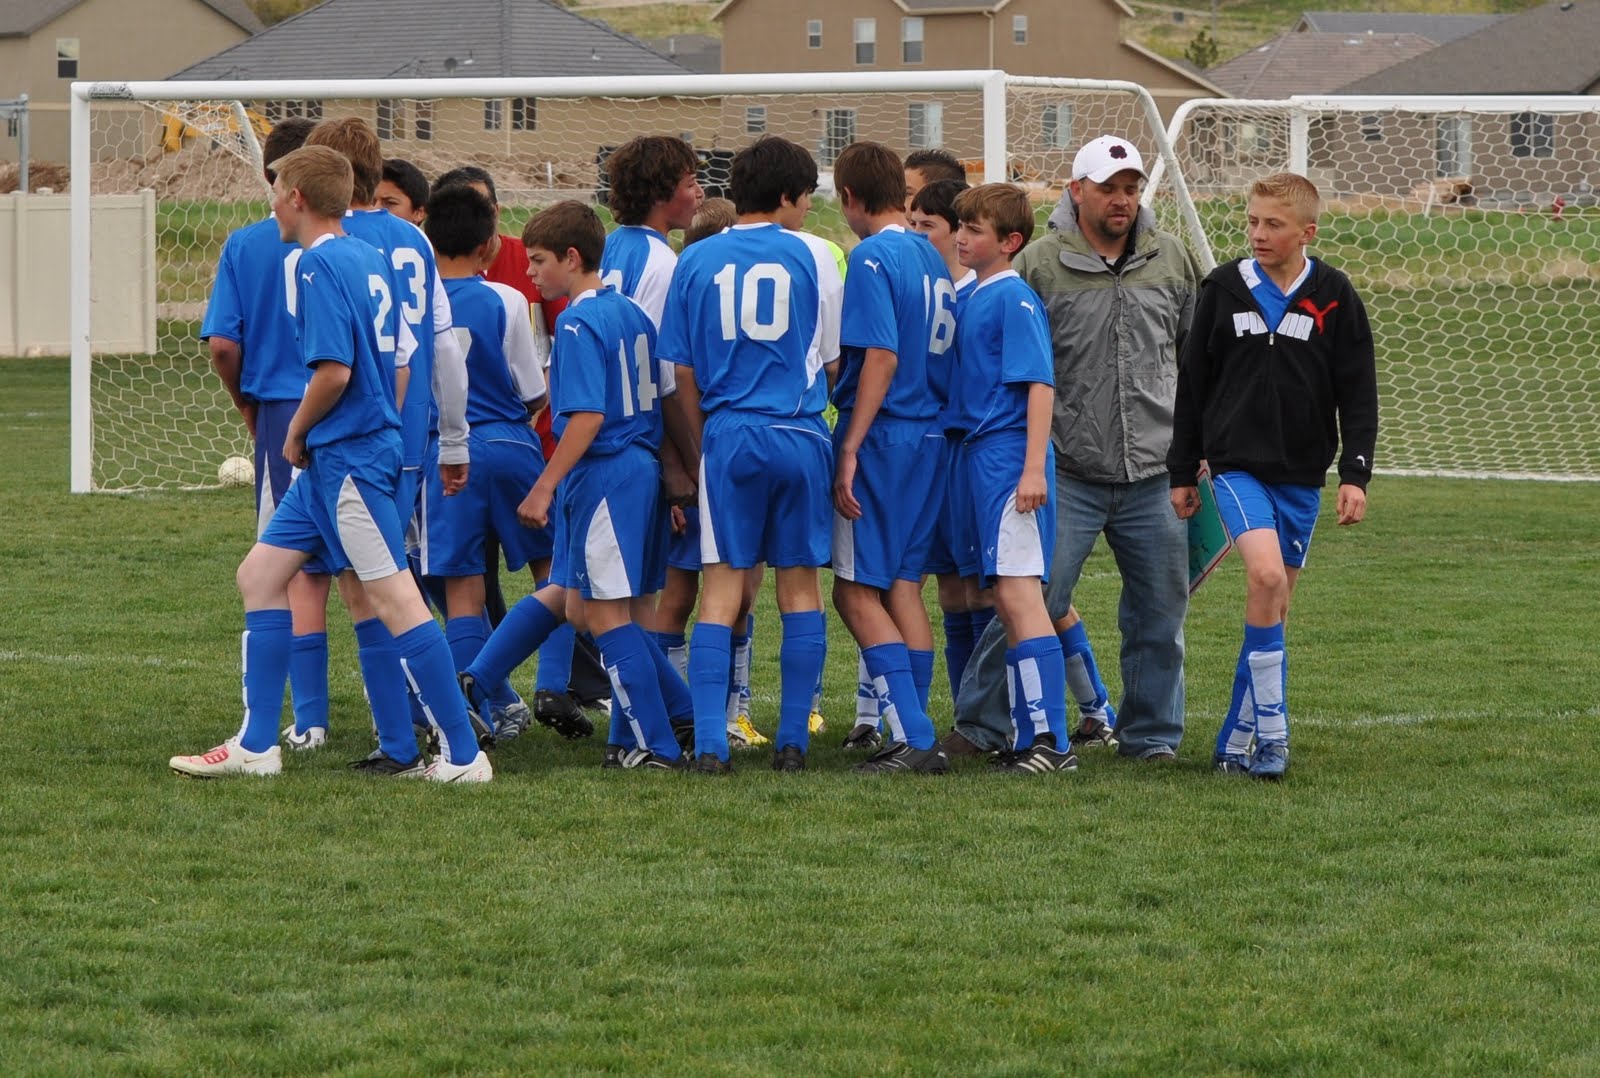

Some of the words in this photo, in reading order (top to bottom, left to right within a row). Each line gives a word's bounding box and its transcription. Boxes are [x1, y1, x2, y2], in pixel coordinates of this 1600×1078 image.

[378, 248, 427, 324] 3
[714, 263, 791, 341] 10
[923, 275, 957, 355] 16
[1232, 311, 1314, 341] PUMA
